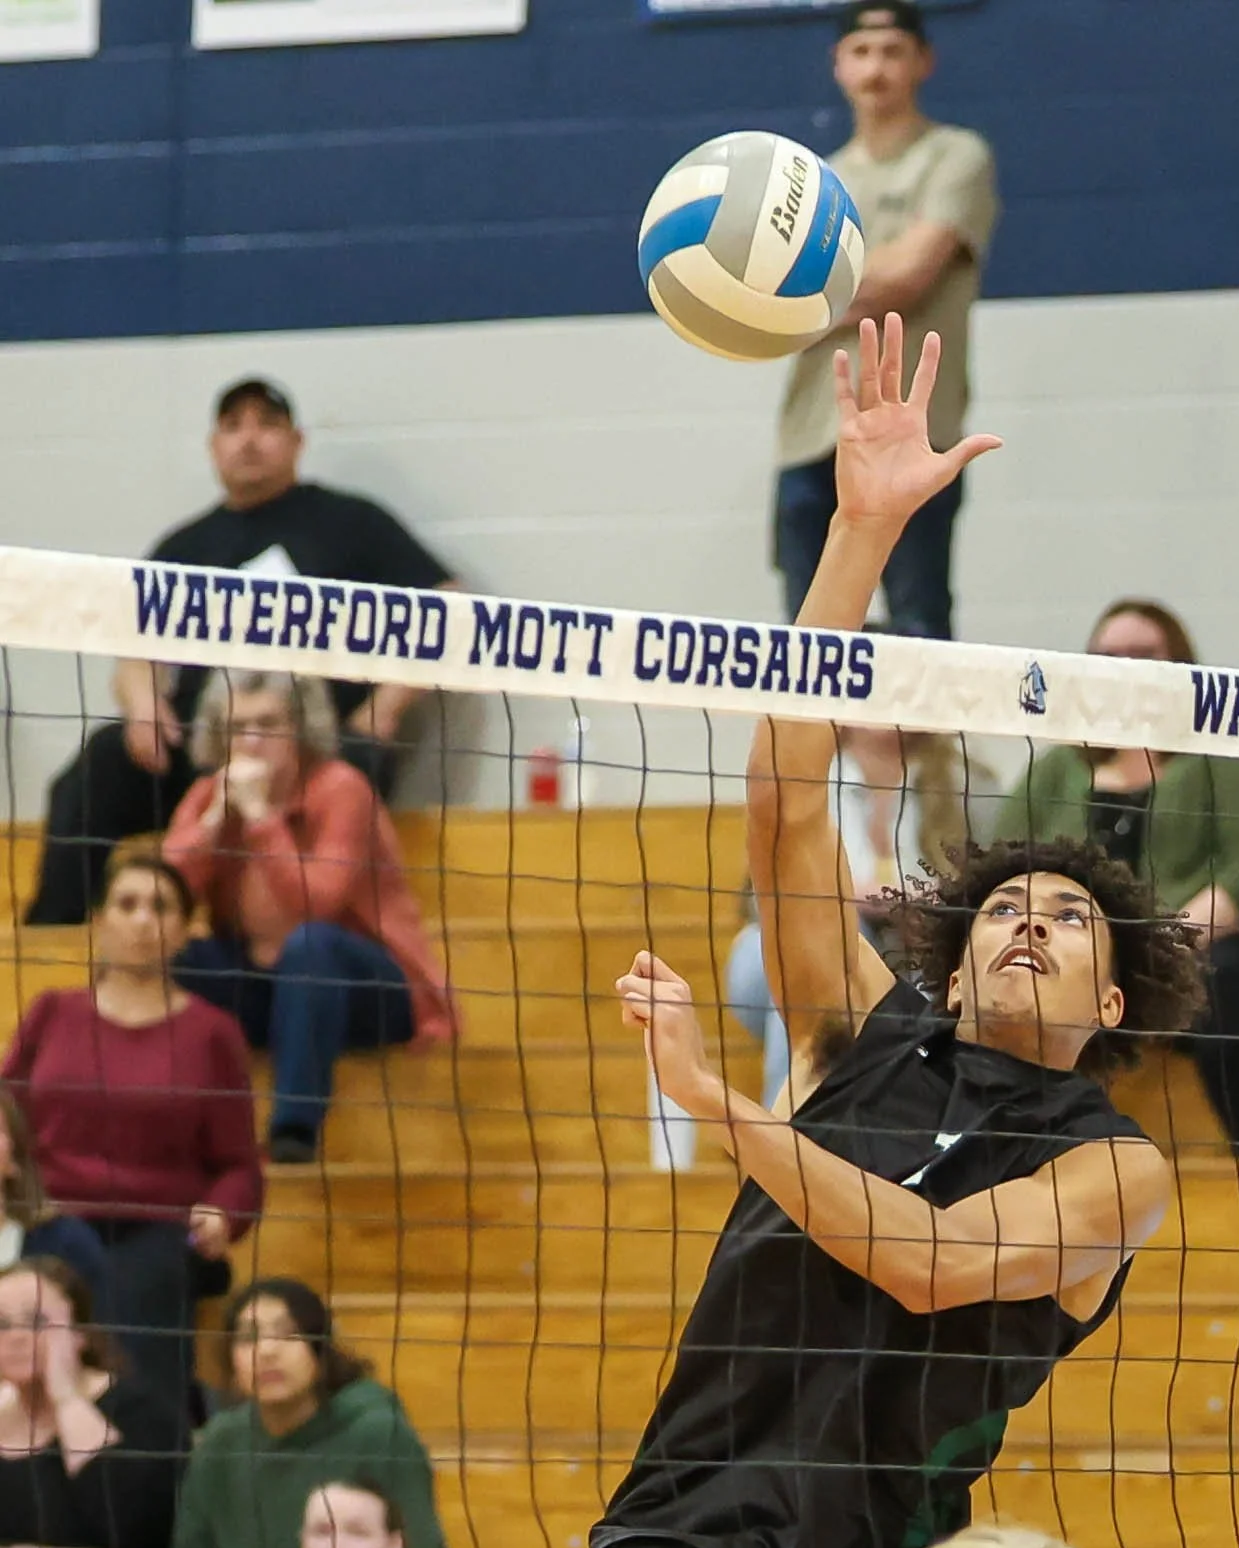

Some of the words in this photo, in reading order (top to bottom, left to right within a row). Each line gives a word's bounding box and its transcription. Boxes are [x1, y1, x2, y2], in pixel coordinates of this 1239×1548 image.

[769, 155, 808, 246] Baden
[132, 566, 448, 661] WATERFORD
[468, 600, 613, 676] MOTT
[633, 617, 875, 700] CORSAIRS
